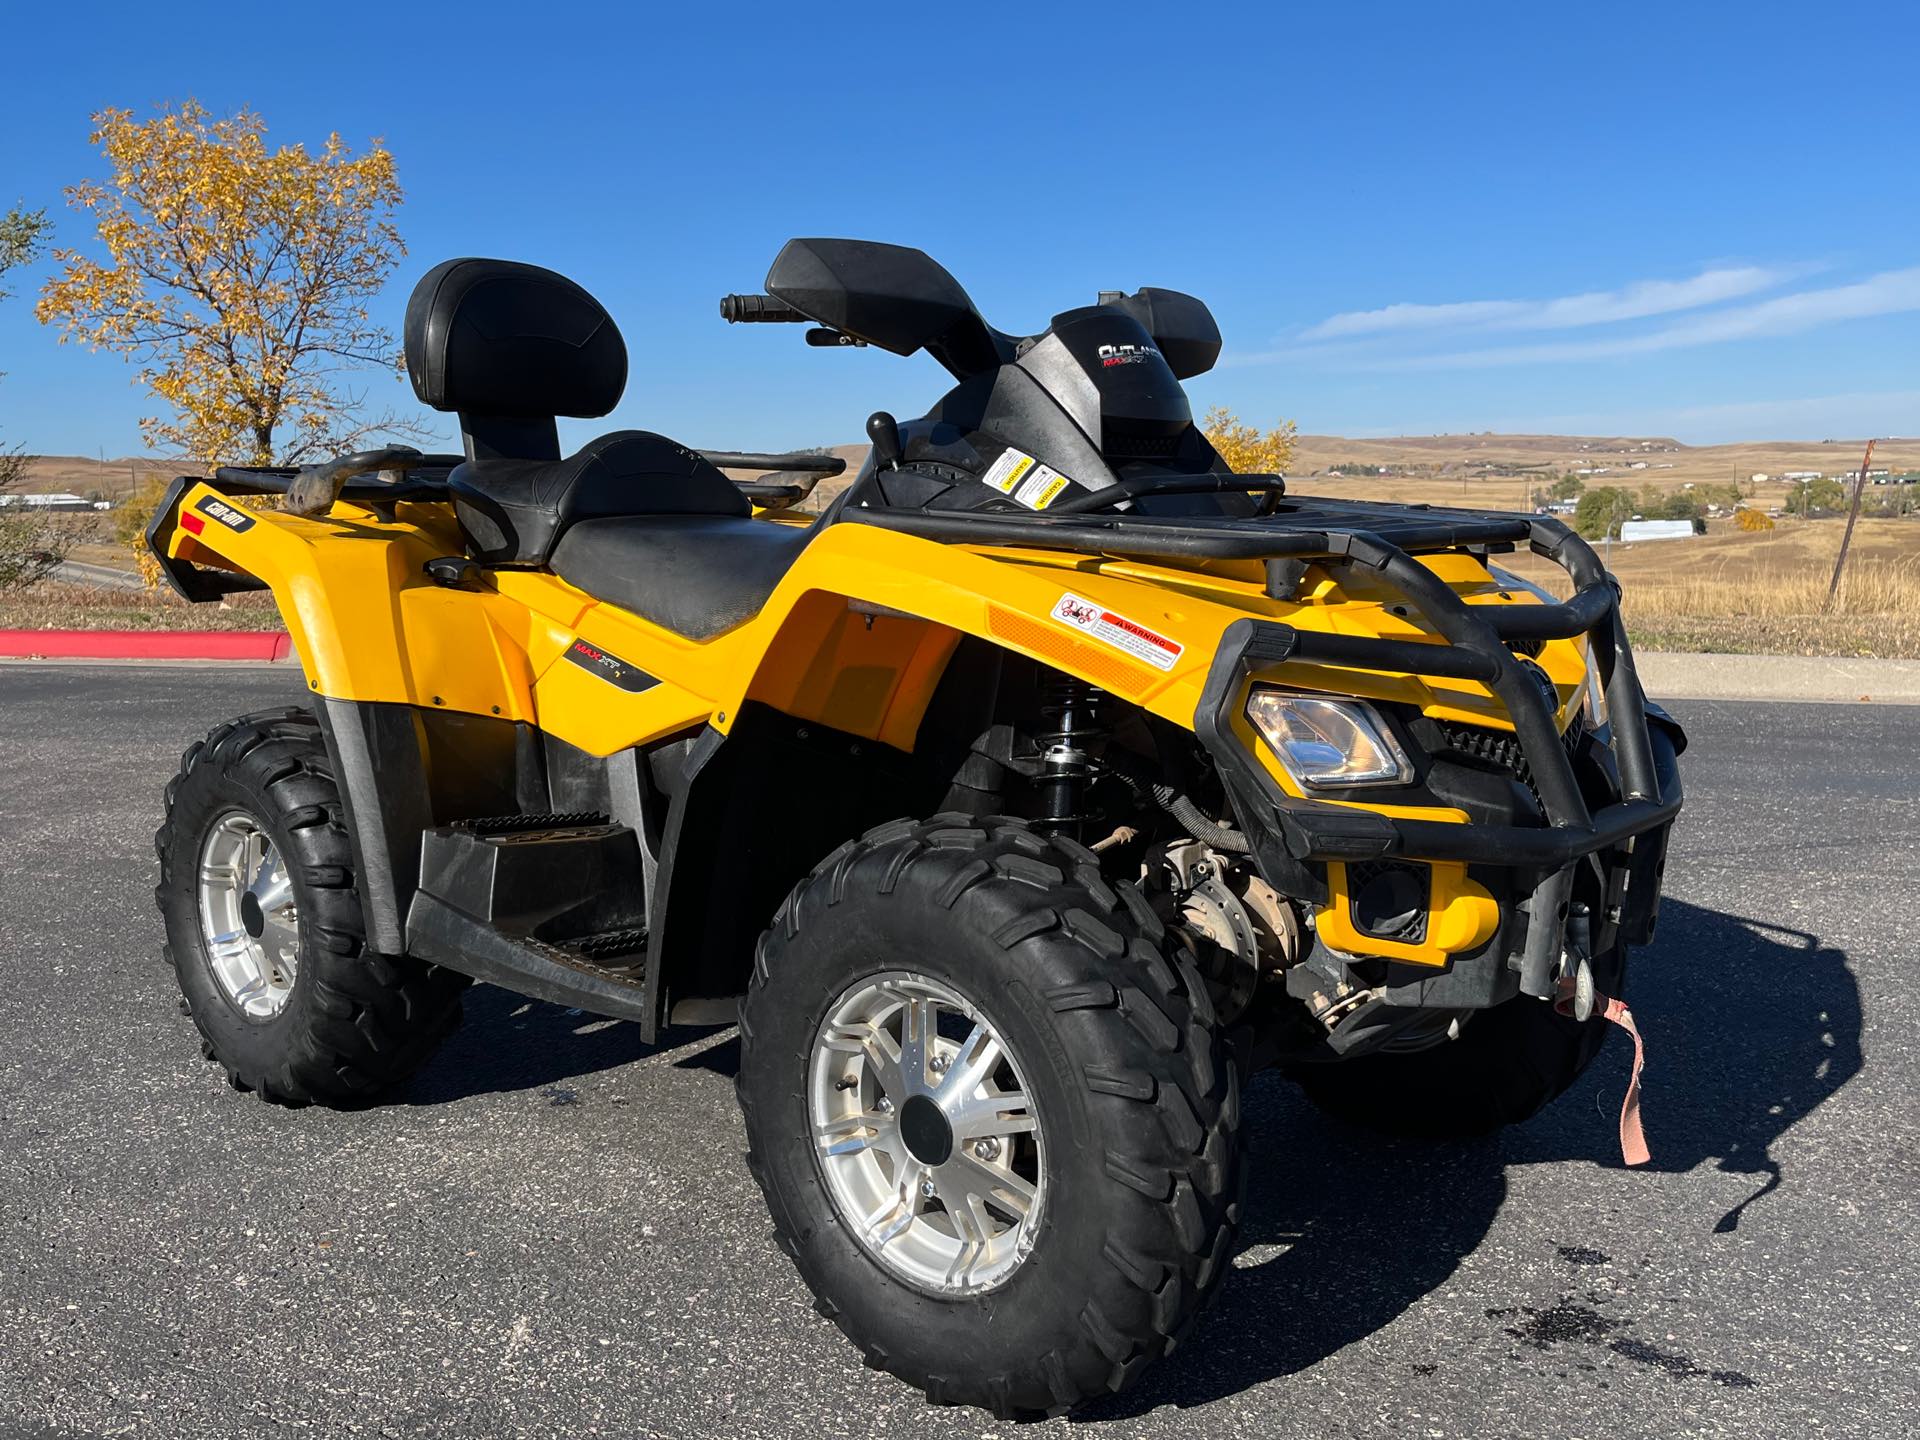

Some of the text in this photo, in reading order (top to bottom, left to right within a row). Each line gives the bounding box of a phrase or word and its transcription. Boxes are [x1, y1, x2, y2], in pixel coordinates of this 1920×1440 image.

[1005, 461, 1028, 486] CAUTION
[1039, 481, 1061, 505] CAUTION
[1124, 623, 1167, 648] WARNING
